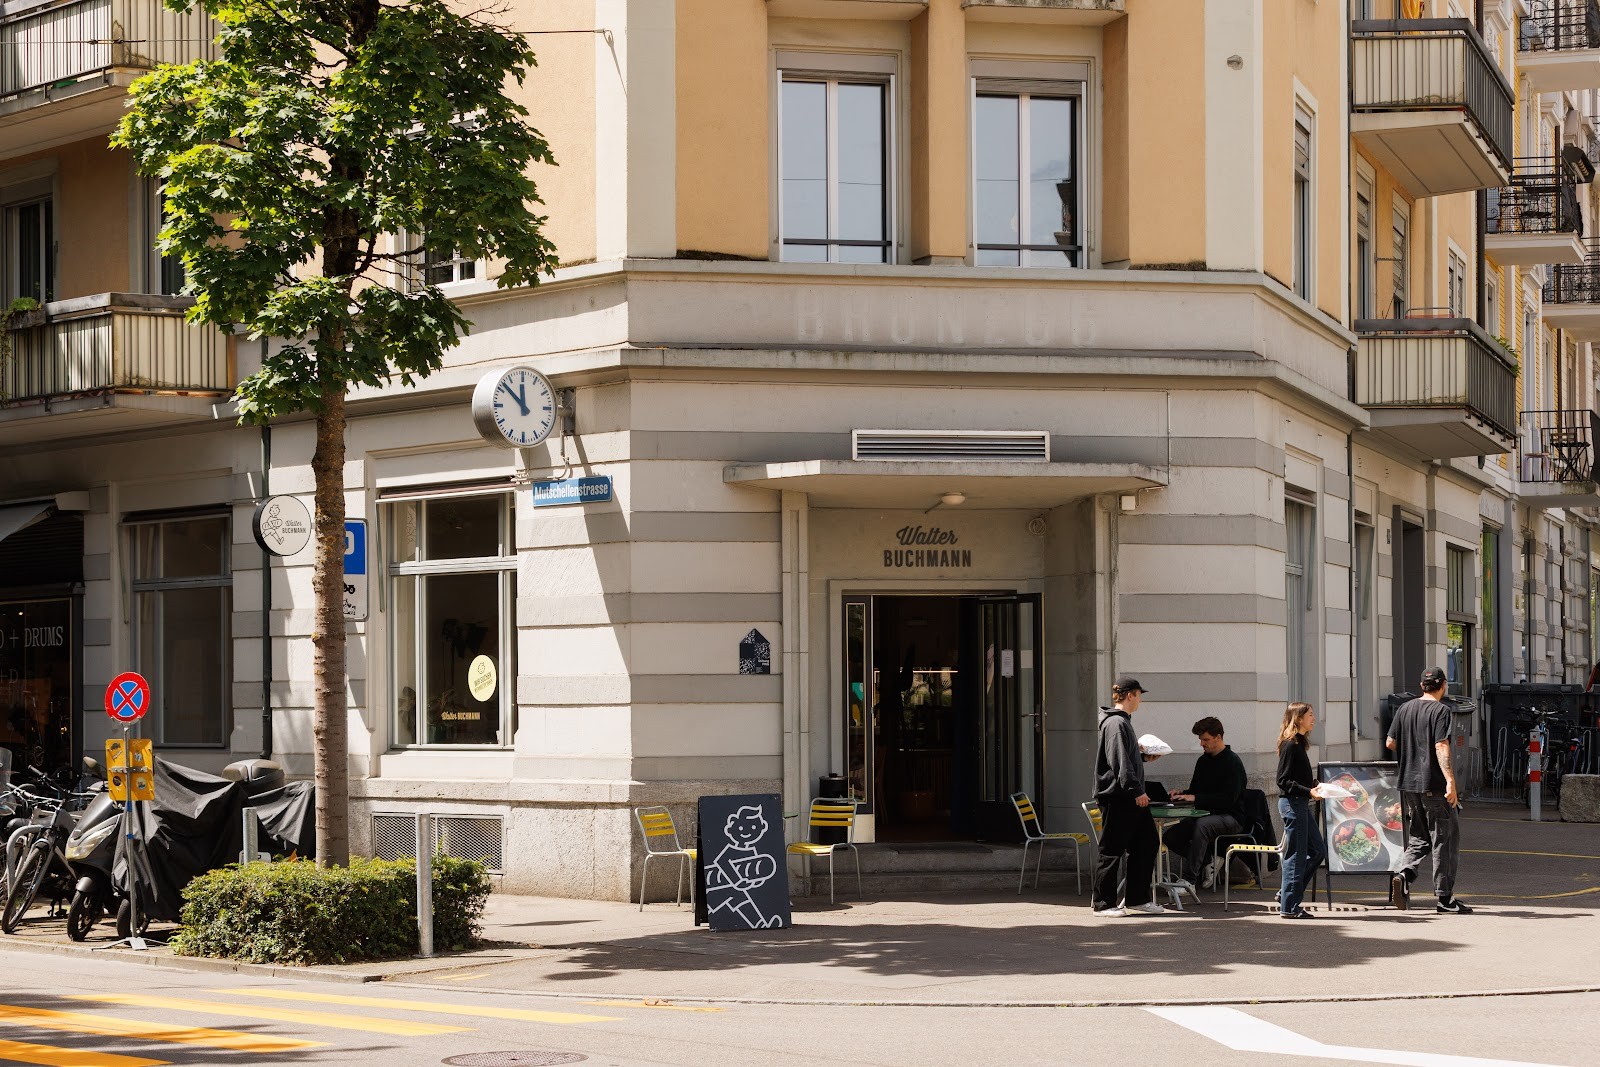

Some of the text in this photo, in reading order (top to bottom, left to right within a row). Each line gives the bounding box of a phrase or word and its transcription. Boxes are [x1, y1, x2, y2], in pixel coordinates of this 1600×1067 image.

[534, 483, 609, 500] Mutschellenstrasse
[896, 525, 958, 546] Walter
[883, 549, 972, 568] BUCHMANN
[24, 625, 64, 648] DRUMS
